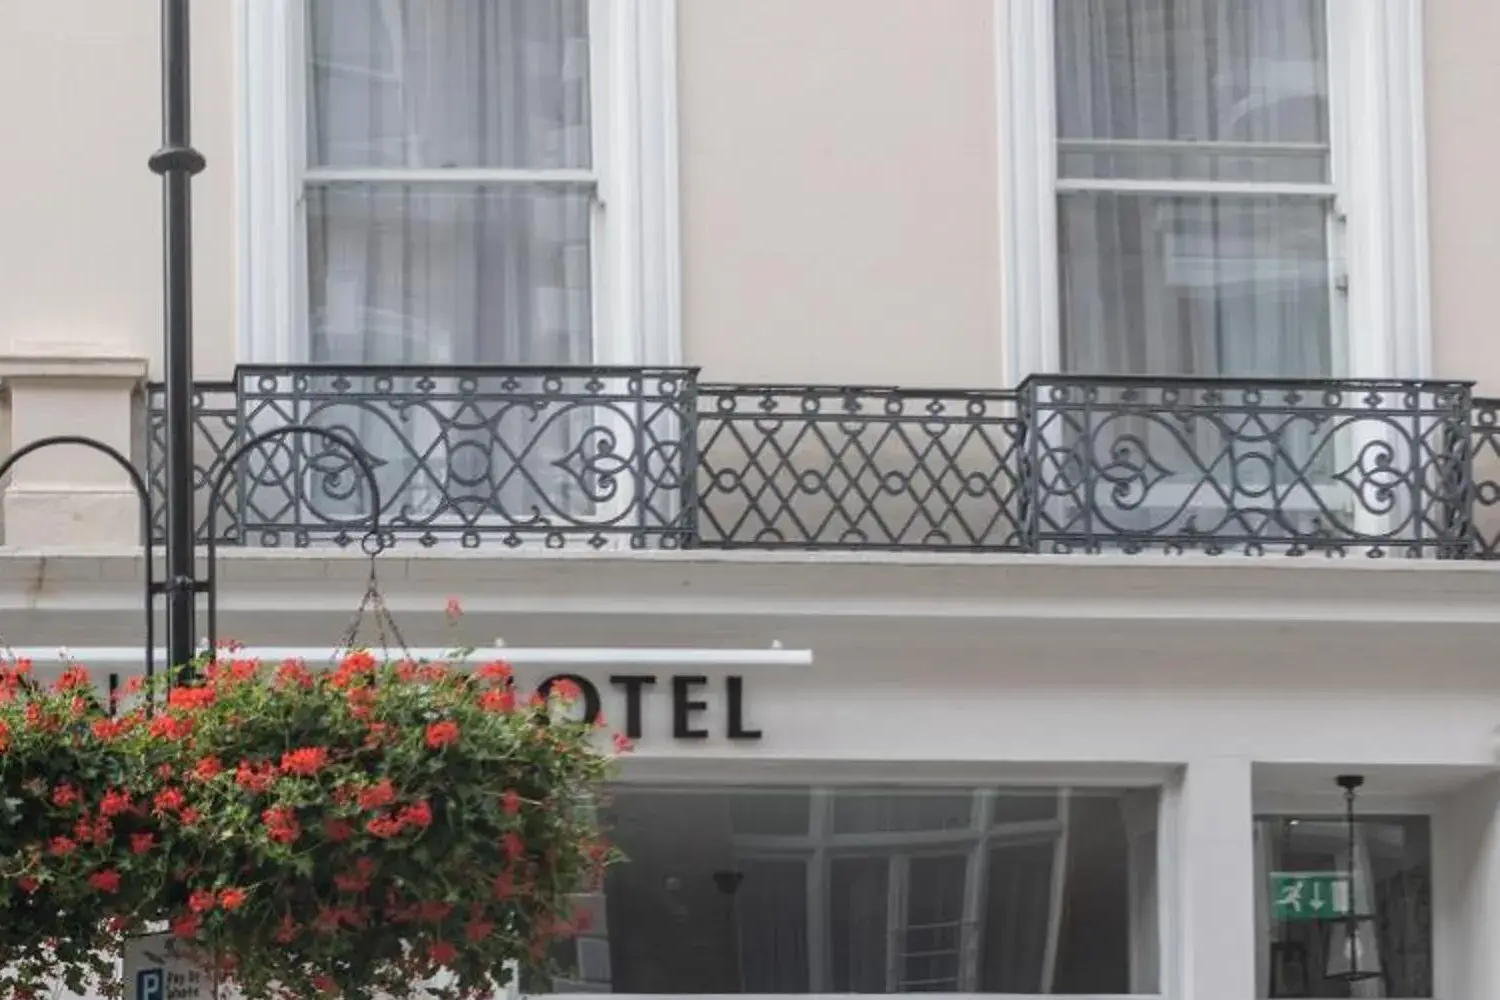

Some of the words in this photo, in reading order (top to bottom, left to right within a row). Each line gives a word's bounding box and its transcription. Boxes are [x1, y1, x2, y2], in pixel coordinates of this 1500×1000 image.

[500, 673, 762, 740] OTEL
[167, 970, 185, 987] Pay
[189, 968, 200, 984] by
